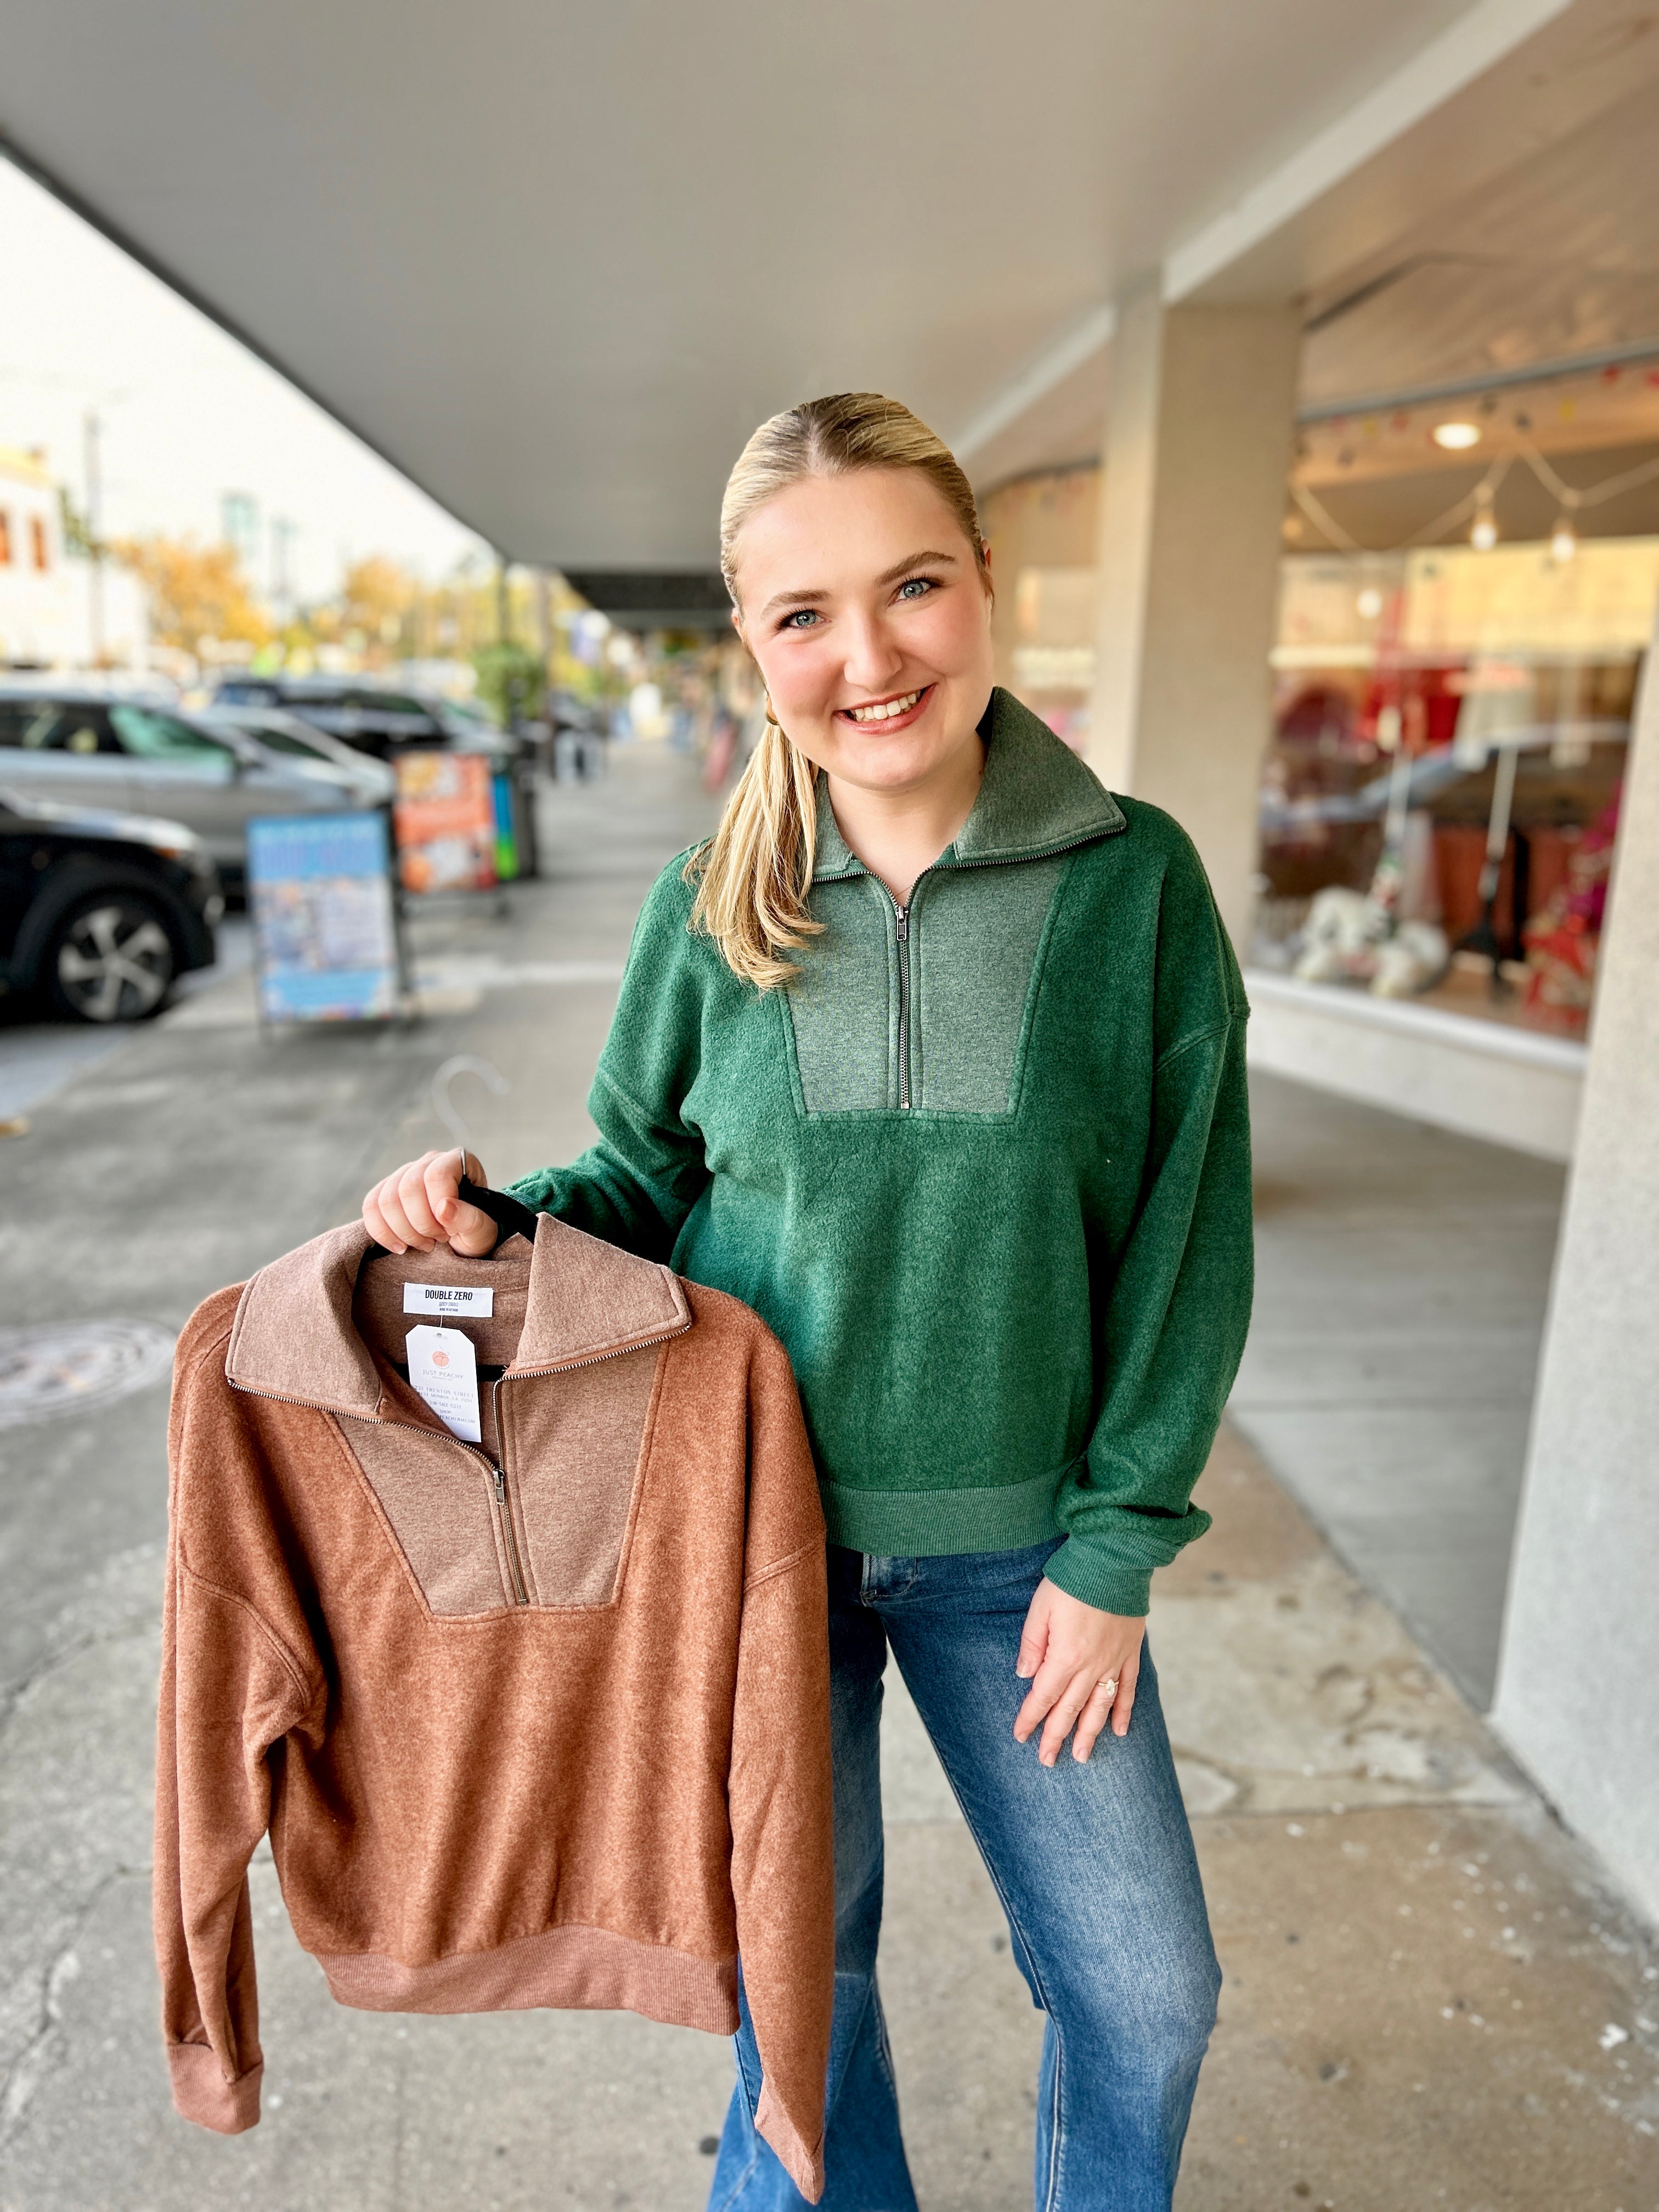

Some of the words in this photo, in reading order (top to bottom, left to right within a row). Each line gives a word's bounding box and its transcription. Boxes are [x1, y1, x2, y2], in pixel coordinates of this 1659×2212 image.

[425, 1289, 453, 1300] DOUBLE
[454, 1291, 473, 1300] ZERO
[426, 1386, 451, 1395] TRENTON
